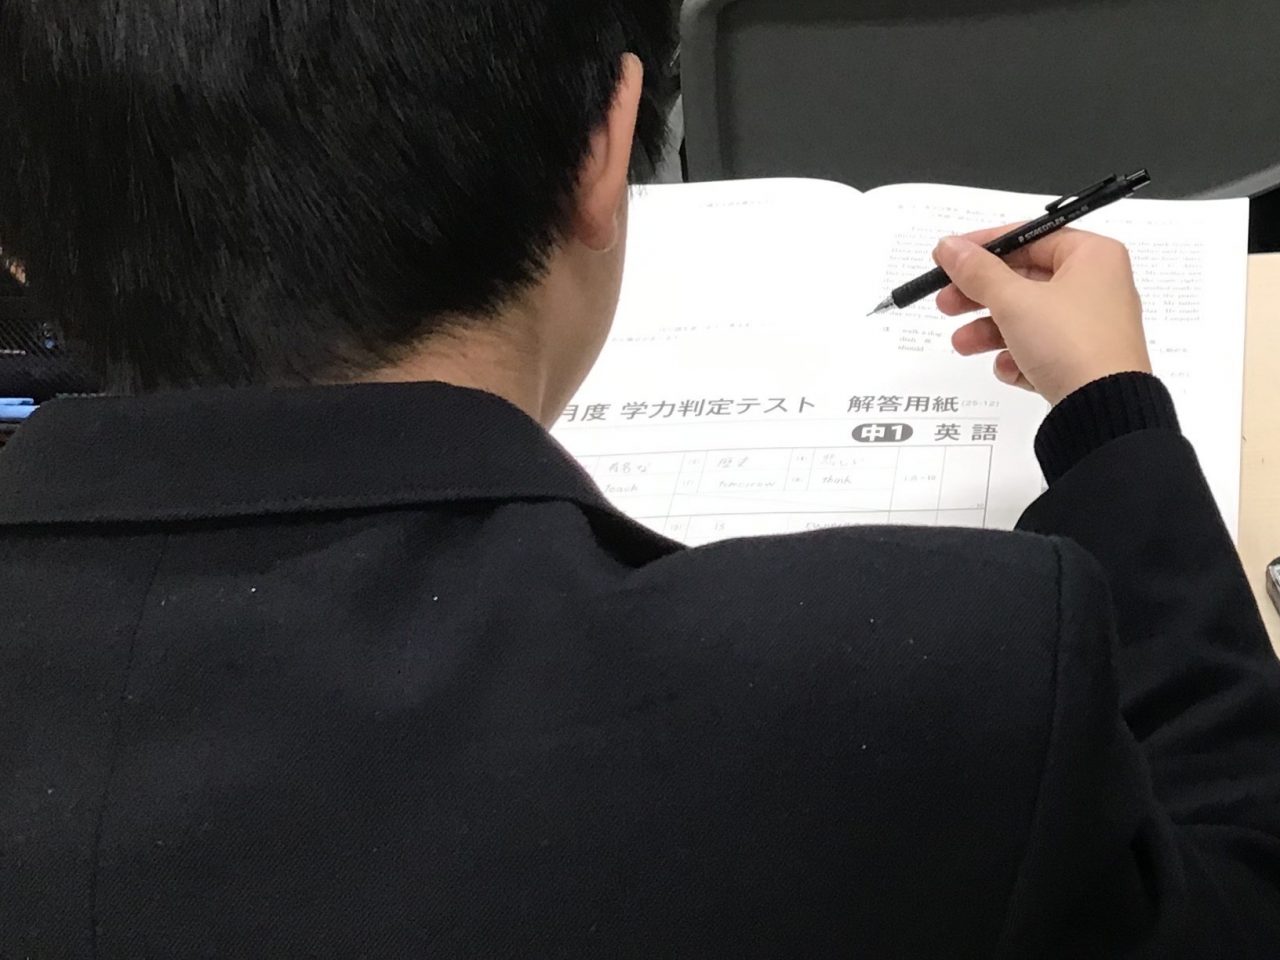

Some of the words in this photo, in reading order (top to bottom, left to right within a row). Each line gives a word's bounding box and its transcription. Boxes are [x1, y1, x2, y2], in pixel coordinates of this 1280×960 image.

[1024, 216, 1066, 241] STAEDTLER
[620, 396, 816, 421] 学力判定テスト
[847, 395, 959, 414] 解答用紙
[860, 424, 904, 442] 中1
